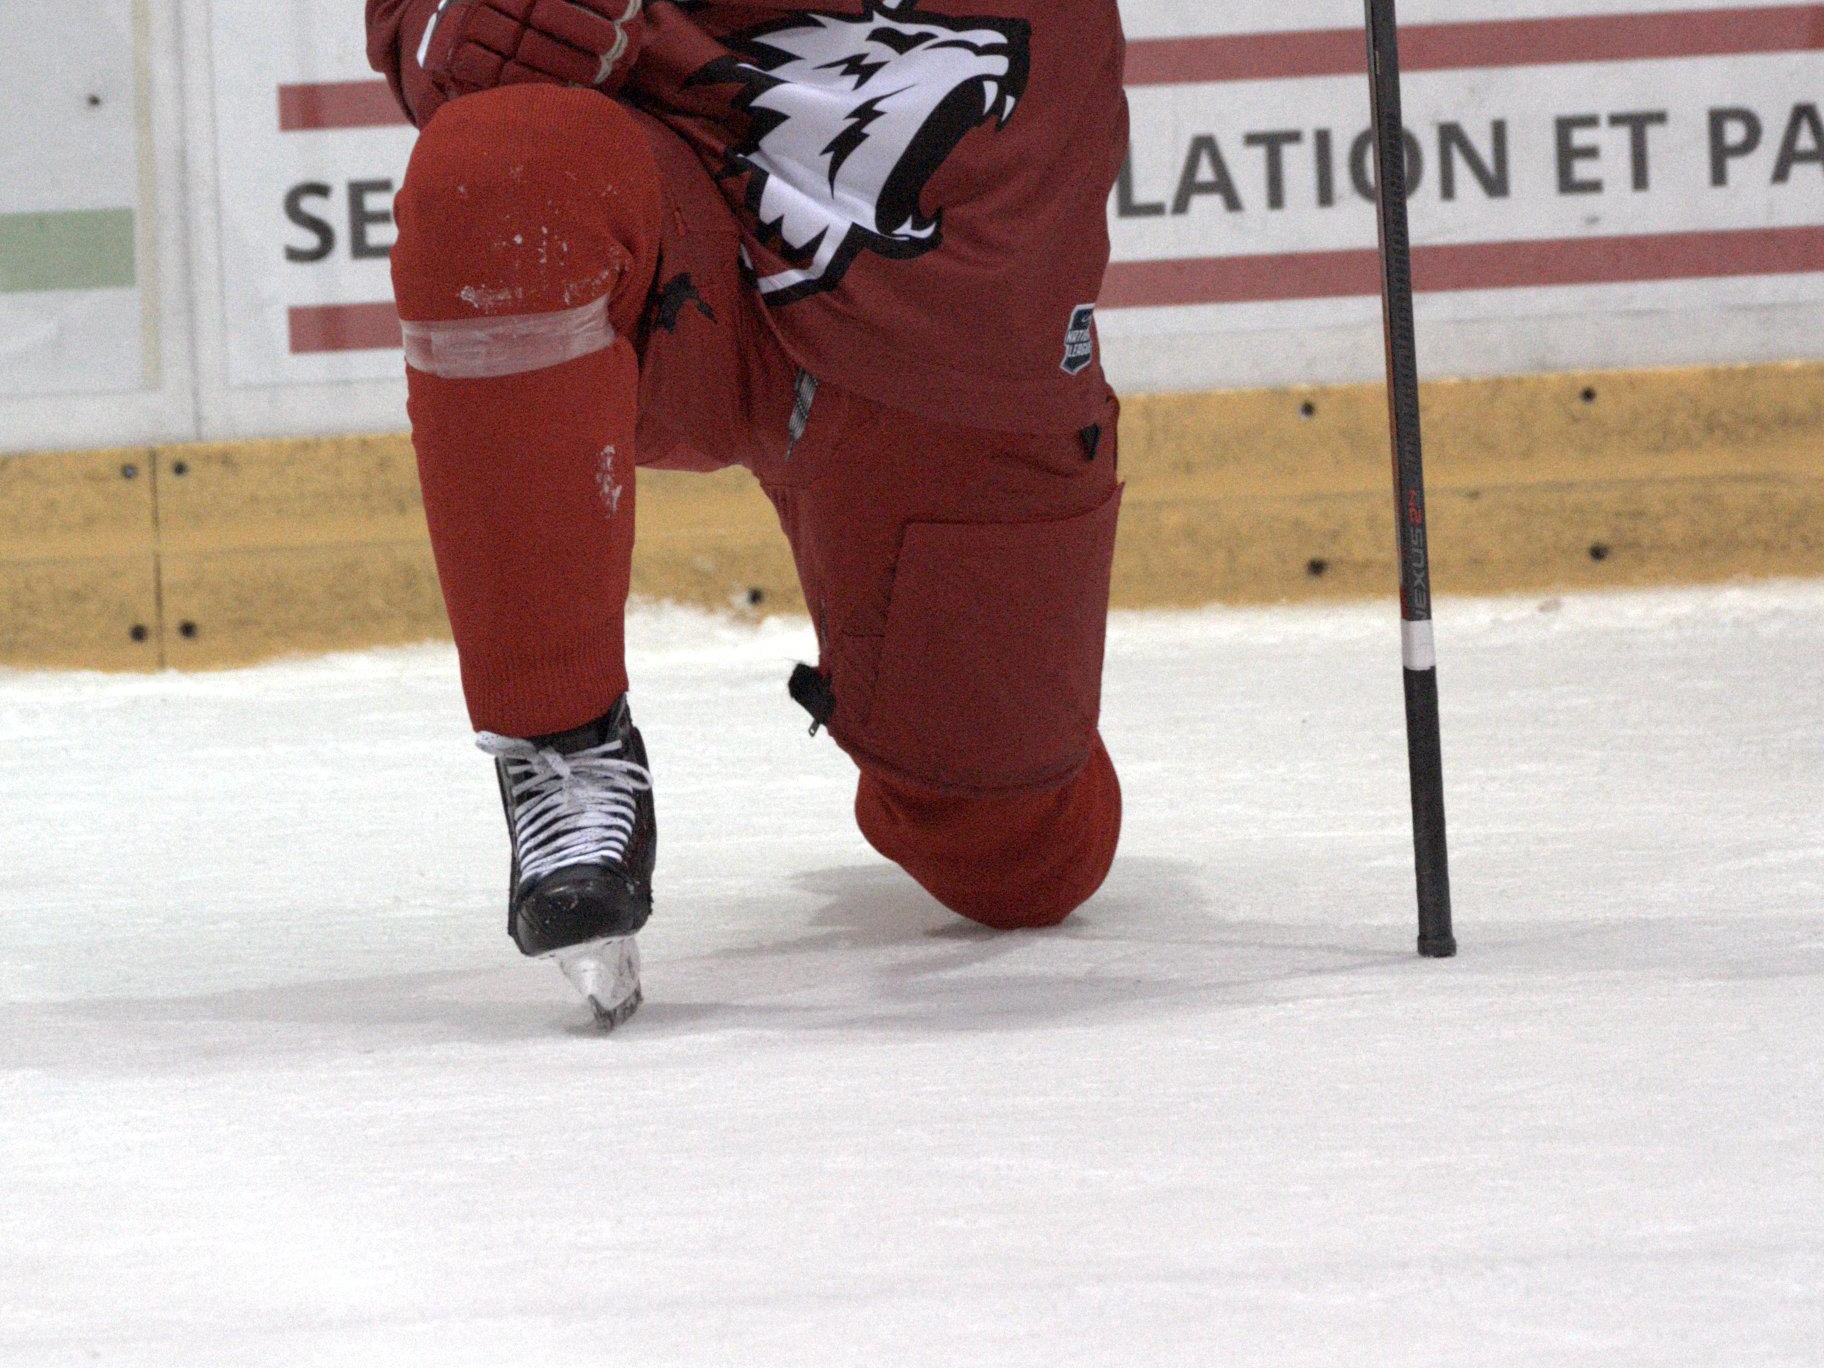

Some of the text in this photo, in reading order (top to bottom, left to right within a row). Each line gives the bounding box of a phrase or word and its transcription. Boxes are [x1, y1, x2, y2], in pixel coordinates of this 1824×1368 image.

[283, 101, 1824, 263] SE LATION ET PA
